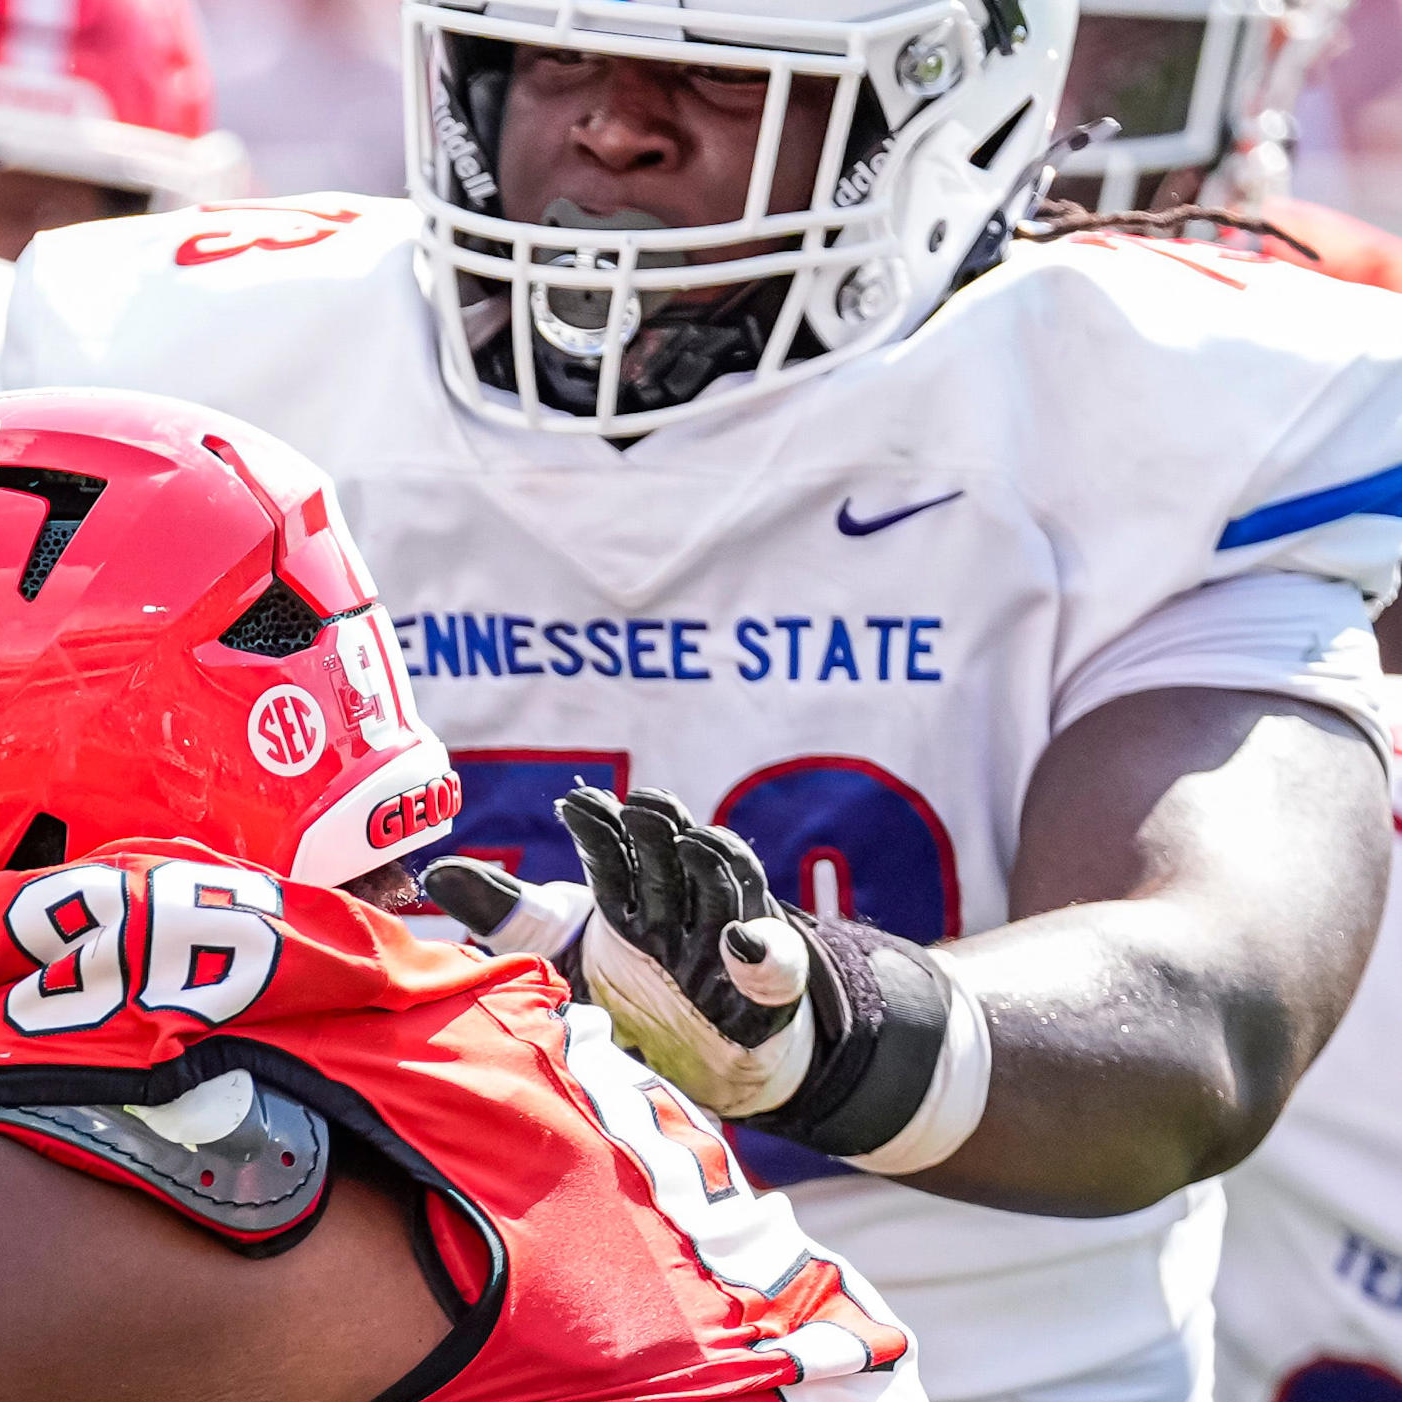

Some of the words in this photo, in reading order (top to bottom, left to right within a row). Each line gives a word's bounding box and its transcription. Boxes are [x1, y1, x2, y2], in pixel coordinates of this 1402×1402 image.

[393, 610, 711, 682] ENNESSEE
[736, 614, 943, 683] STATE
[257, 695, 317, 765] SEC
[3, 859, 286, 1037] 96
